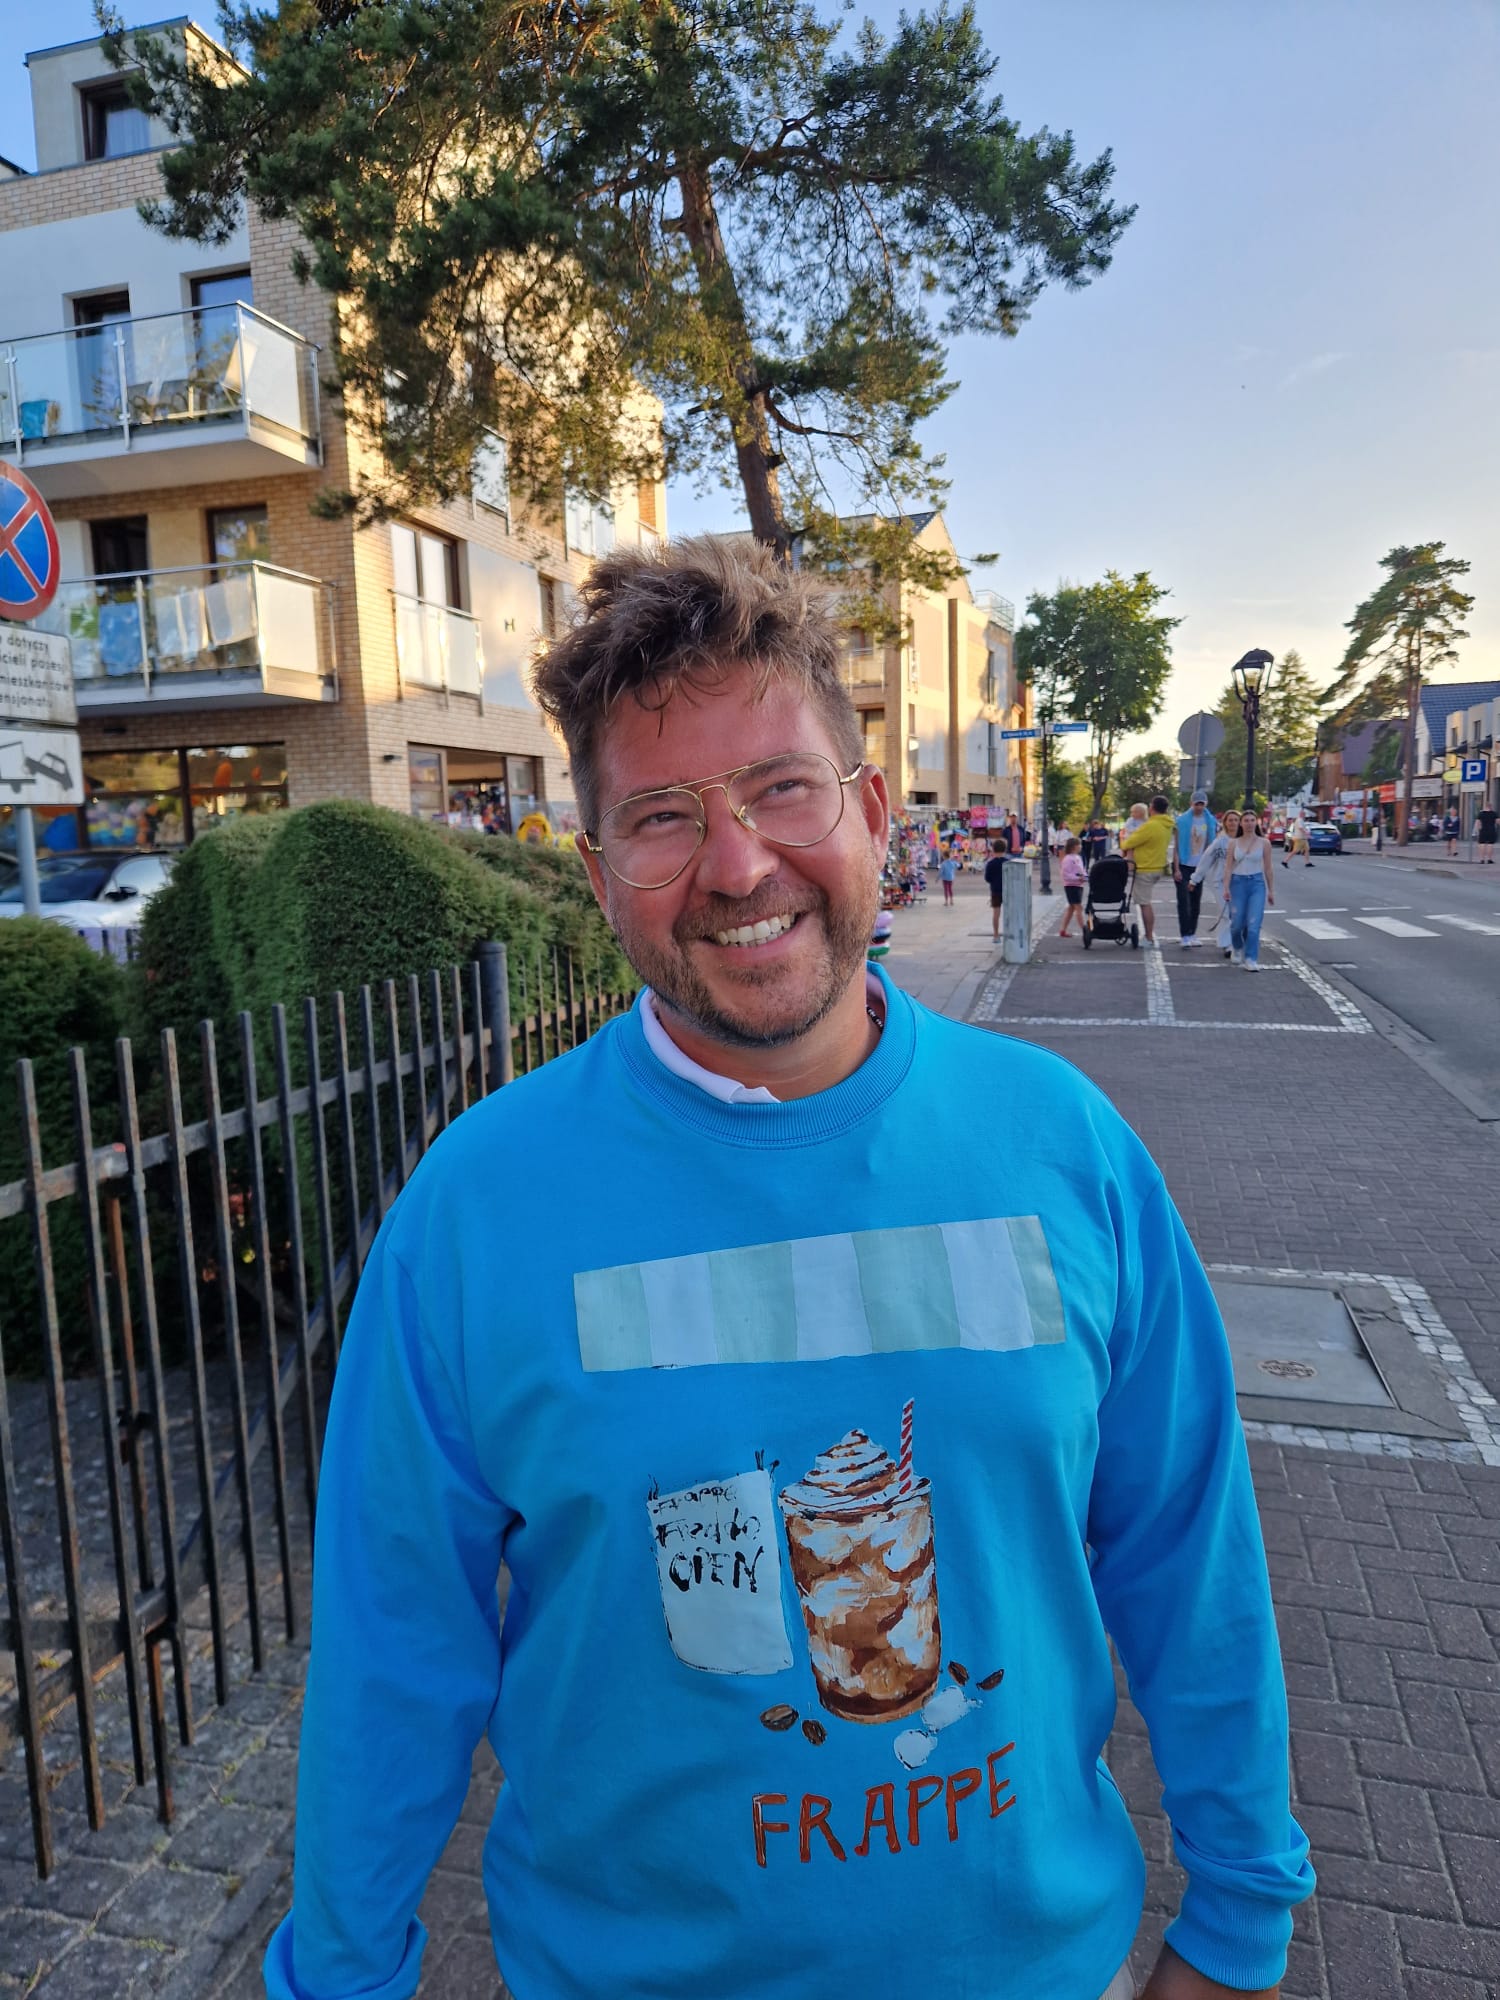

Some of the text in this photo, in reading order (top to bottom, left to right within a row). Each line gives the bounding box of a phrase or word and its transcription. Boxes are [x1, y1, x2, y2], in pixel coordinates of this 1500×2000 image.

[1466, 762, 1481, 780] P
[668, 1546, 765, 1593] OPEN
[752, 1741, 1017, 1868] FRAPPE
